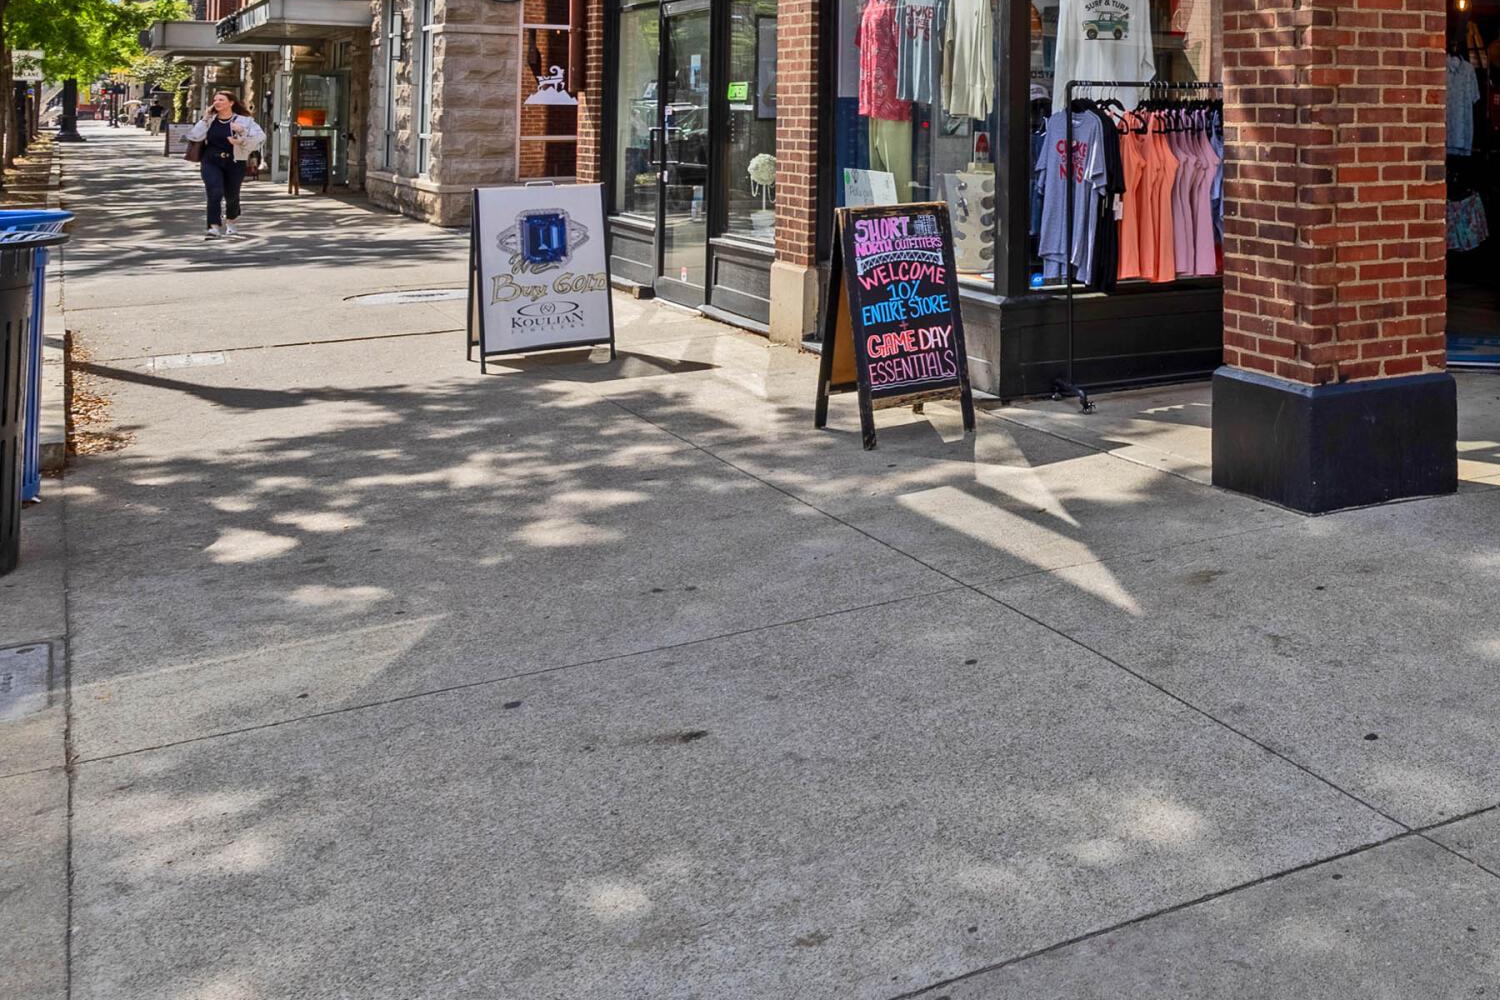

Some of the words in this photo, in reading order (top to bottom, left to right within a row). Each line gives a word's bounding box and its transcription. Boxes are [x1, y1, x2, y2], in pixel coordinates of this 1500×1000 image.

[1085, 0, 1103, 11] SURF
[1112, 0, 1130, 12] TURF
[854, 216, 909, 242] SHORT
[855, 239, 893, 257] NORTH
[895, 236, 943, 250] OUTFITTERS
[858, 262, 946, 290] WELCOME
[887, 279, 920, 301] 10%
[512, 311, 583, 328] KOULIAN
[862, 300, 908, 326] ENTIRE
[908, 294, 951, 318] STORE
[867, 329, 918, 358] GAME
[918, 325, 952, 350] DAY
[868, 350, 957, 385] ESSENTIALS
